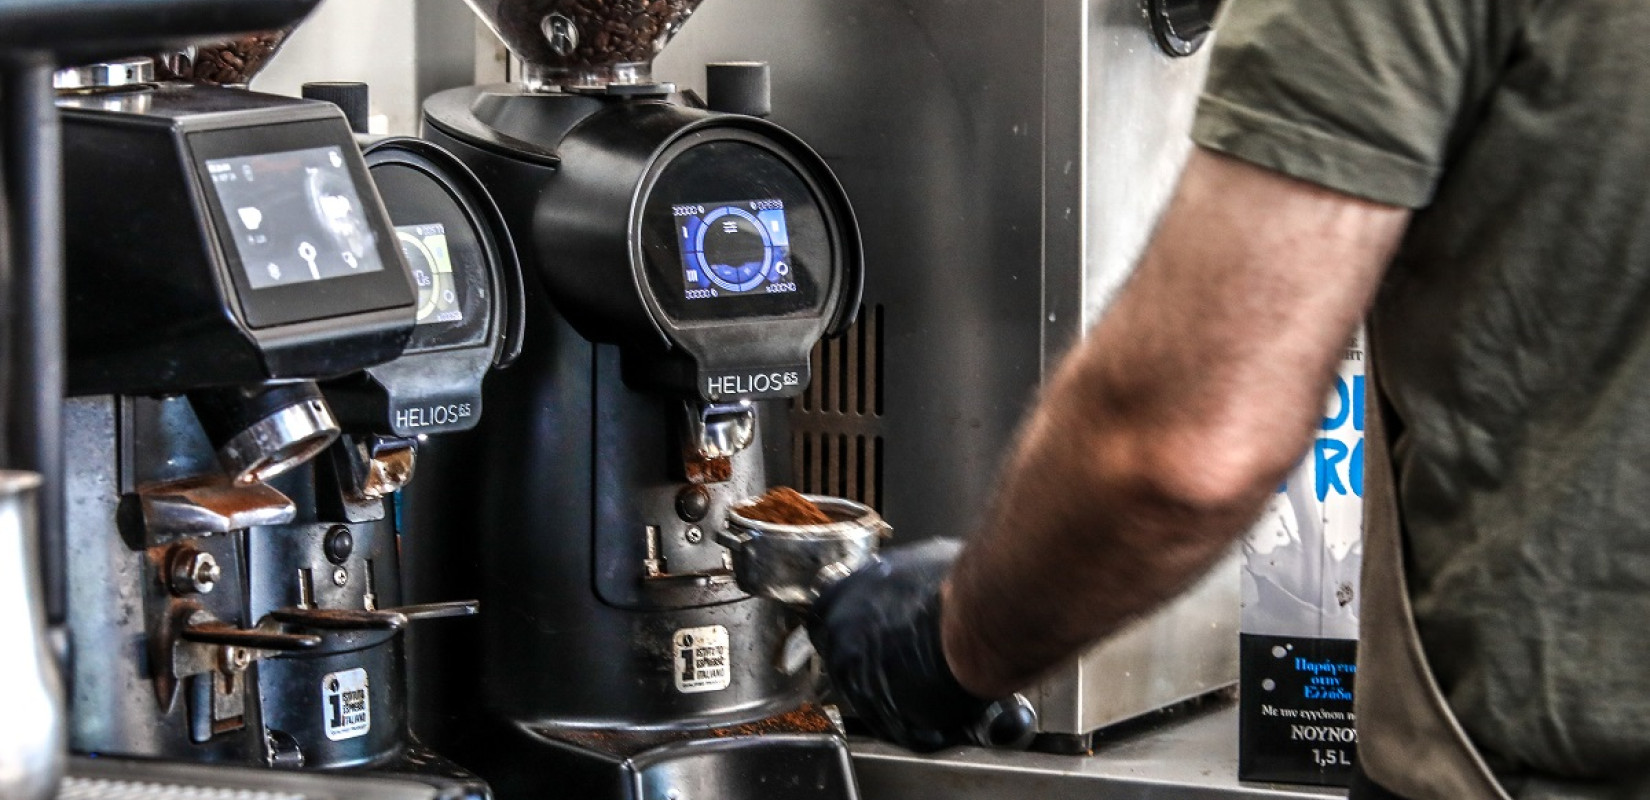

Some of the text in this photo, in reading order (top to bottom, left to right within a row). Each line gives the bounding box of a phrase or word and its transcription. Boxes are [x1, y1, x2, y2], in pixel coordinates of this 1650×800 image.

[708, 371, 798, 394] HELIOS 65
[396, 403, 471, 427] HELIOS 65
[1295, 657, 1357, 675] Παράγετα
[1312, 748, 1351, 767] 1,5 L
